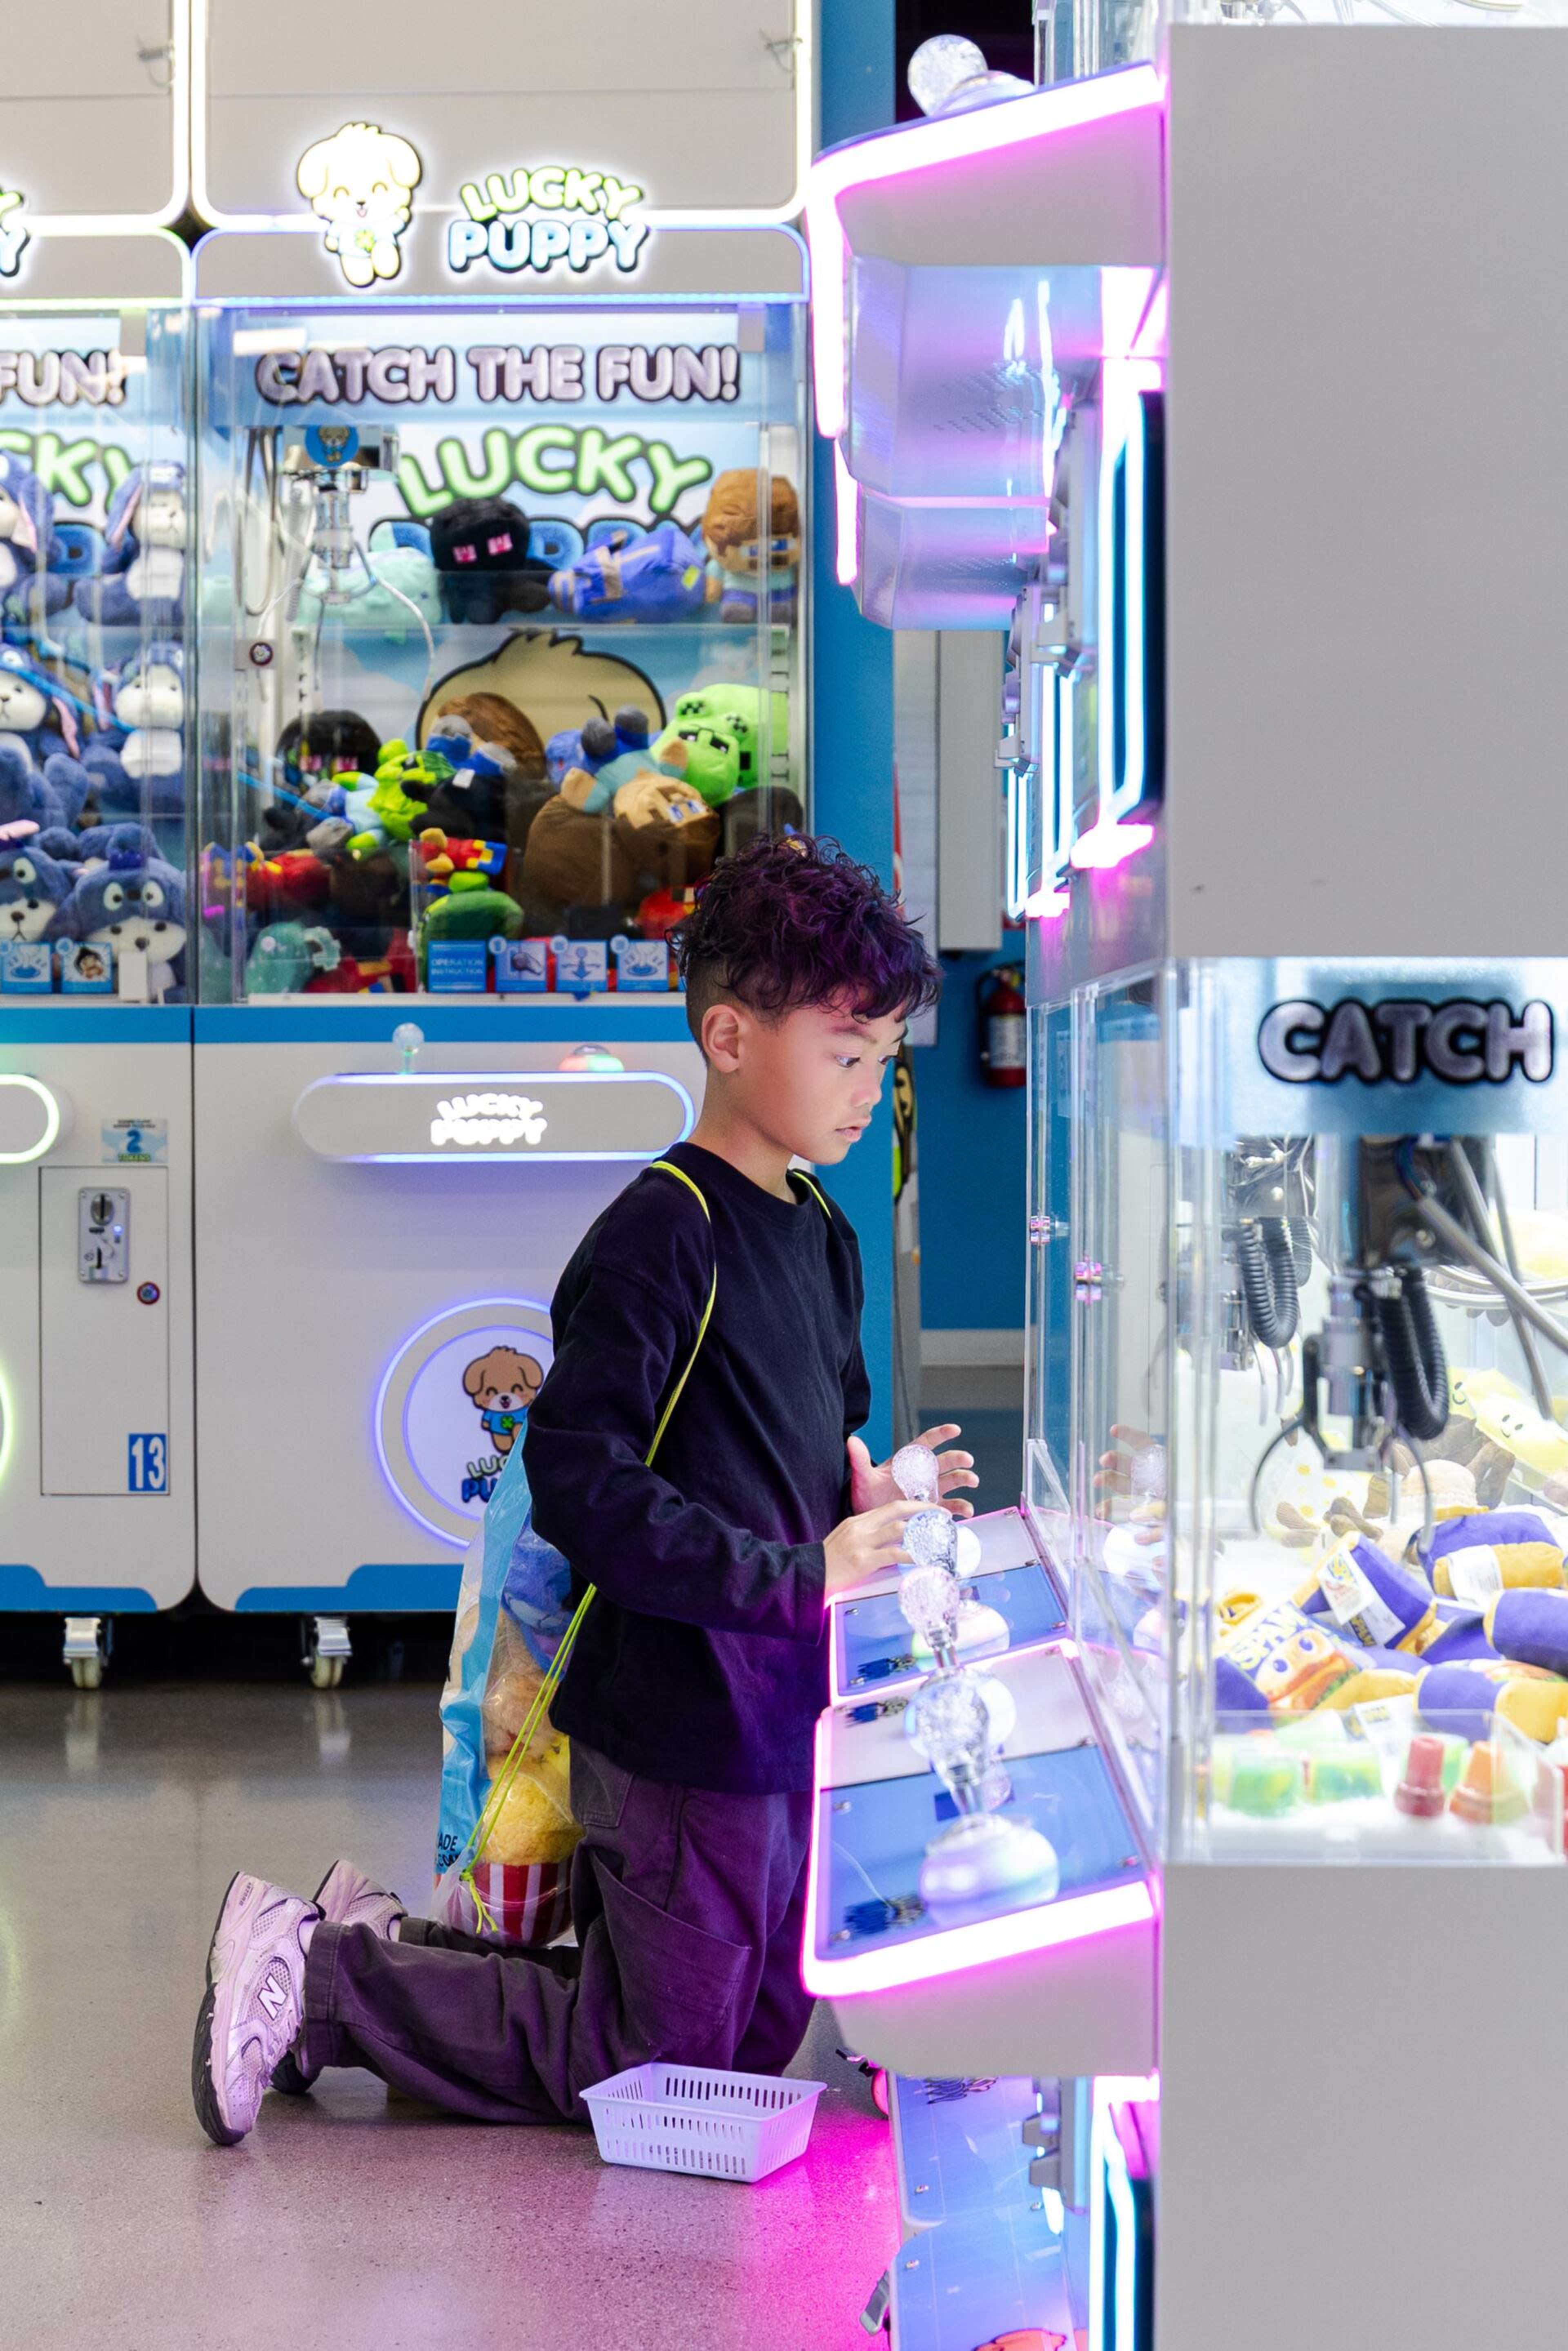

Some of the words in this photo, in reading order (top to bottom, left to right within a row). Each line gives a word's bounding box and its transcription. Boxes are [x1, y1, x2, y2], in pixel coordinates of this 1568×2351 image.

[461, 165, 644, 222] LUCKY
[449, 220, 649, 273] PUPPY
[255, 346, 456, 407] CATCH
[467, 345, 585, 402] THE
[596, 345, 740, 402] FUN!
[397, 424, 713, 519] LUCKY
[1257, 997, 1555, 1085] CATCH
[127, 1129, 142, 1154] 2
[131, 1436, 165, 1489] 13
